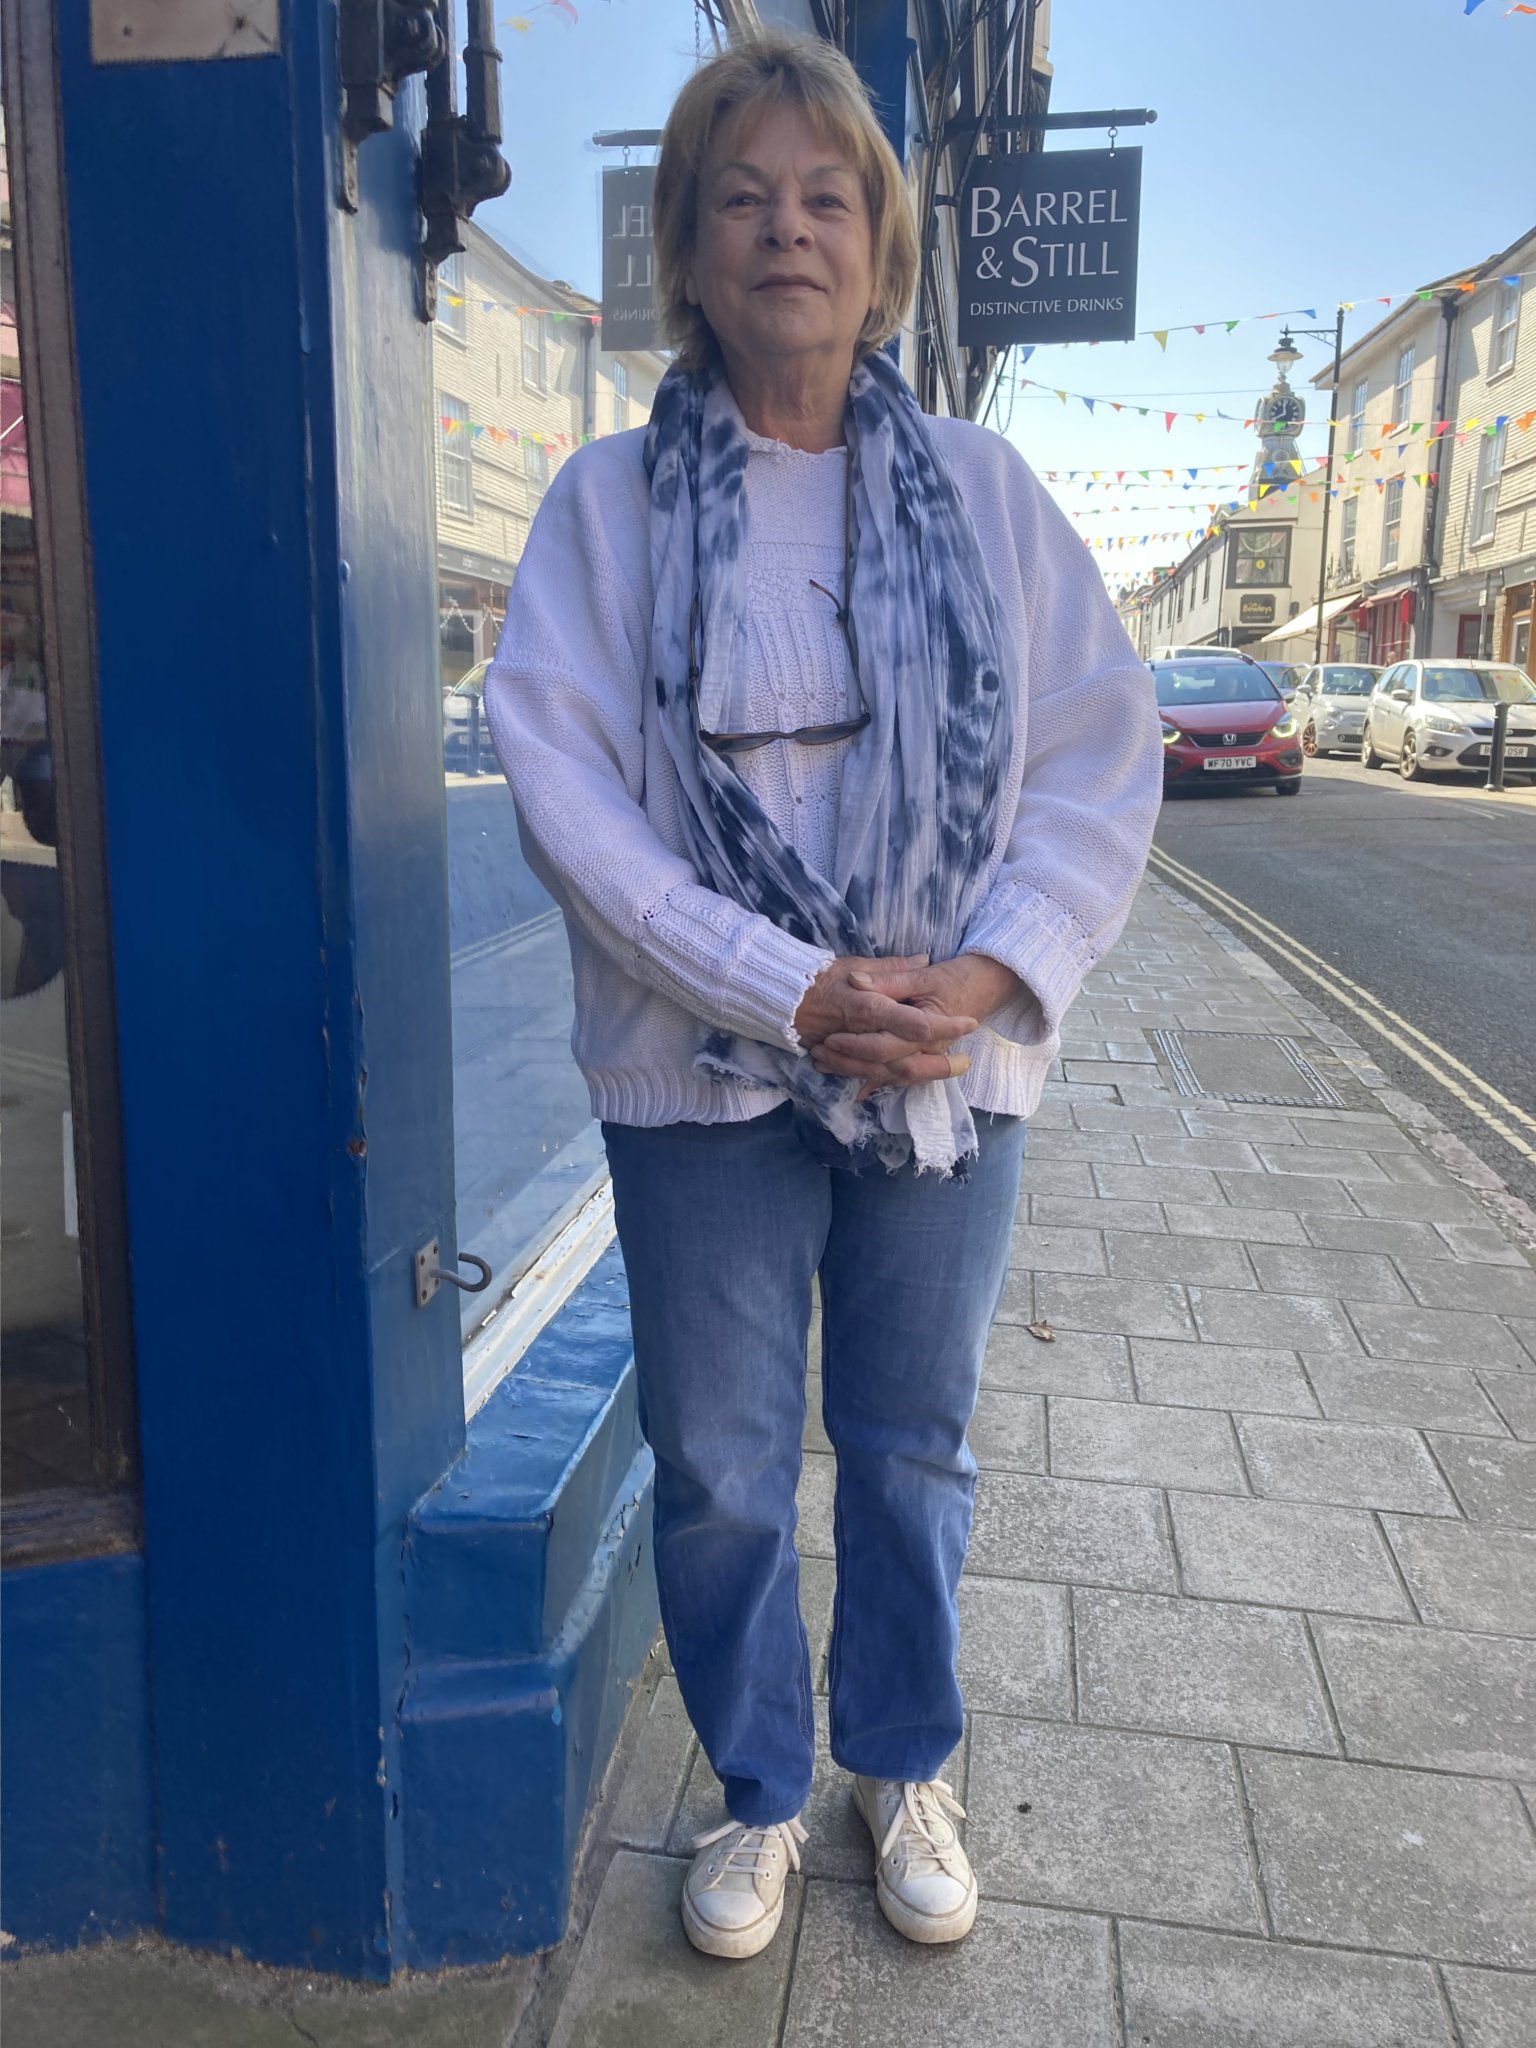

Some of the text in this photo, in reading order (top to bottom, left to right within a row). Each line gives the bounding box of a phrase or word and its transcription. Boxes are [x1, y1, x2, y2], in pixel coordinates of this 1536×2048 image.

[970, 186, 1128, 238] BARREL
[975, 235, 1120, 288] & STILL
[970, 297, 1124, 316] DISTINCTIVE DRINKS
[1207, 757, 1253, 769] WF70 YVC
